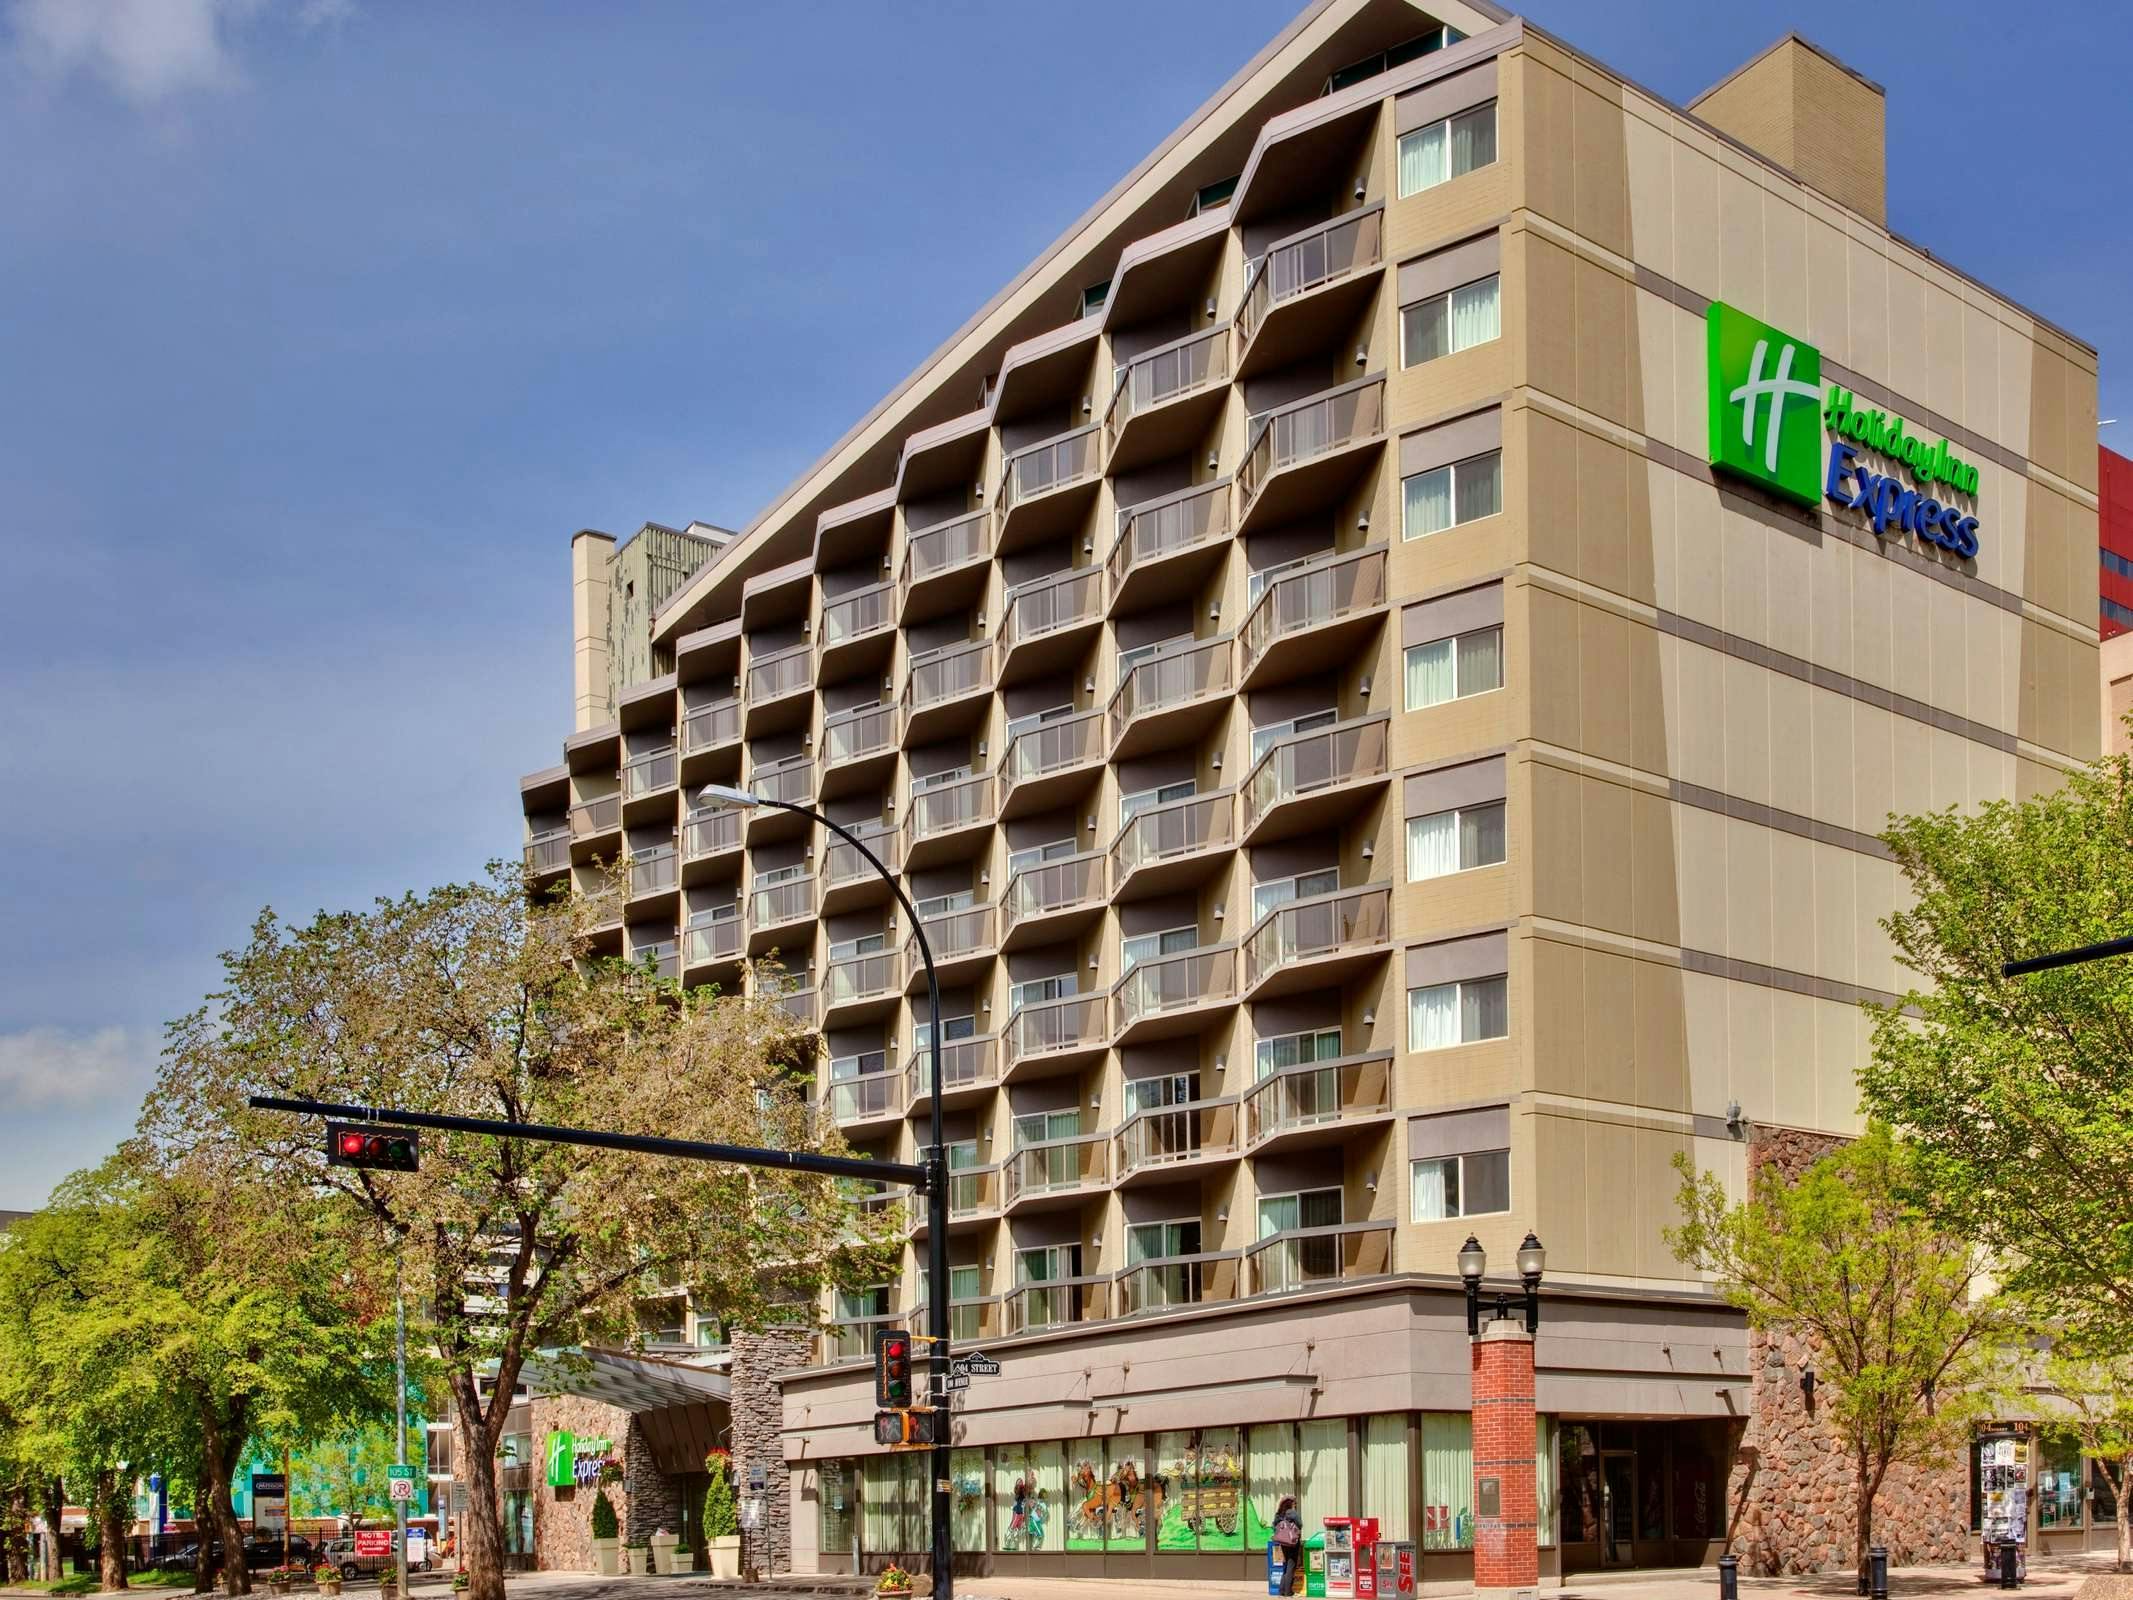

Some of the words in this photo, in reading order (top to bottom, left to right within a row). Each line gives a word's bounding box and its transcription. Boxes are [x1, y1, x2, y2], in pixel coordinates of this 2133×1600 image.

[1823, 384, 1936, 484] Holiday
[1933, 437, 1979, 498] Inn
[1825, 441, 1980, 560] Express
[970, 1363, 998, 1373] STREET
[572, 1437, 596, 1456] Holiday
[389, 1467, 402, 1476] 105
[572, 1456, 606, 1483] Expres
[1397, 1551, 1414, 1594] SEE
